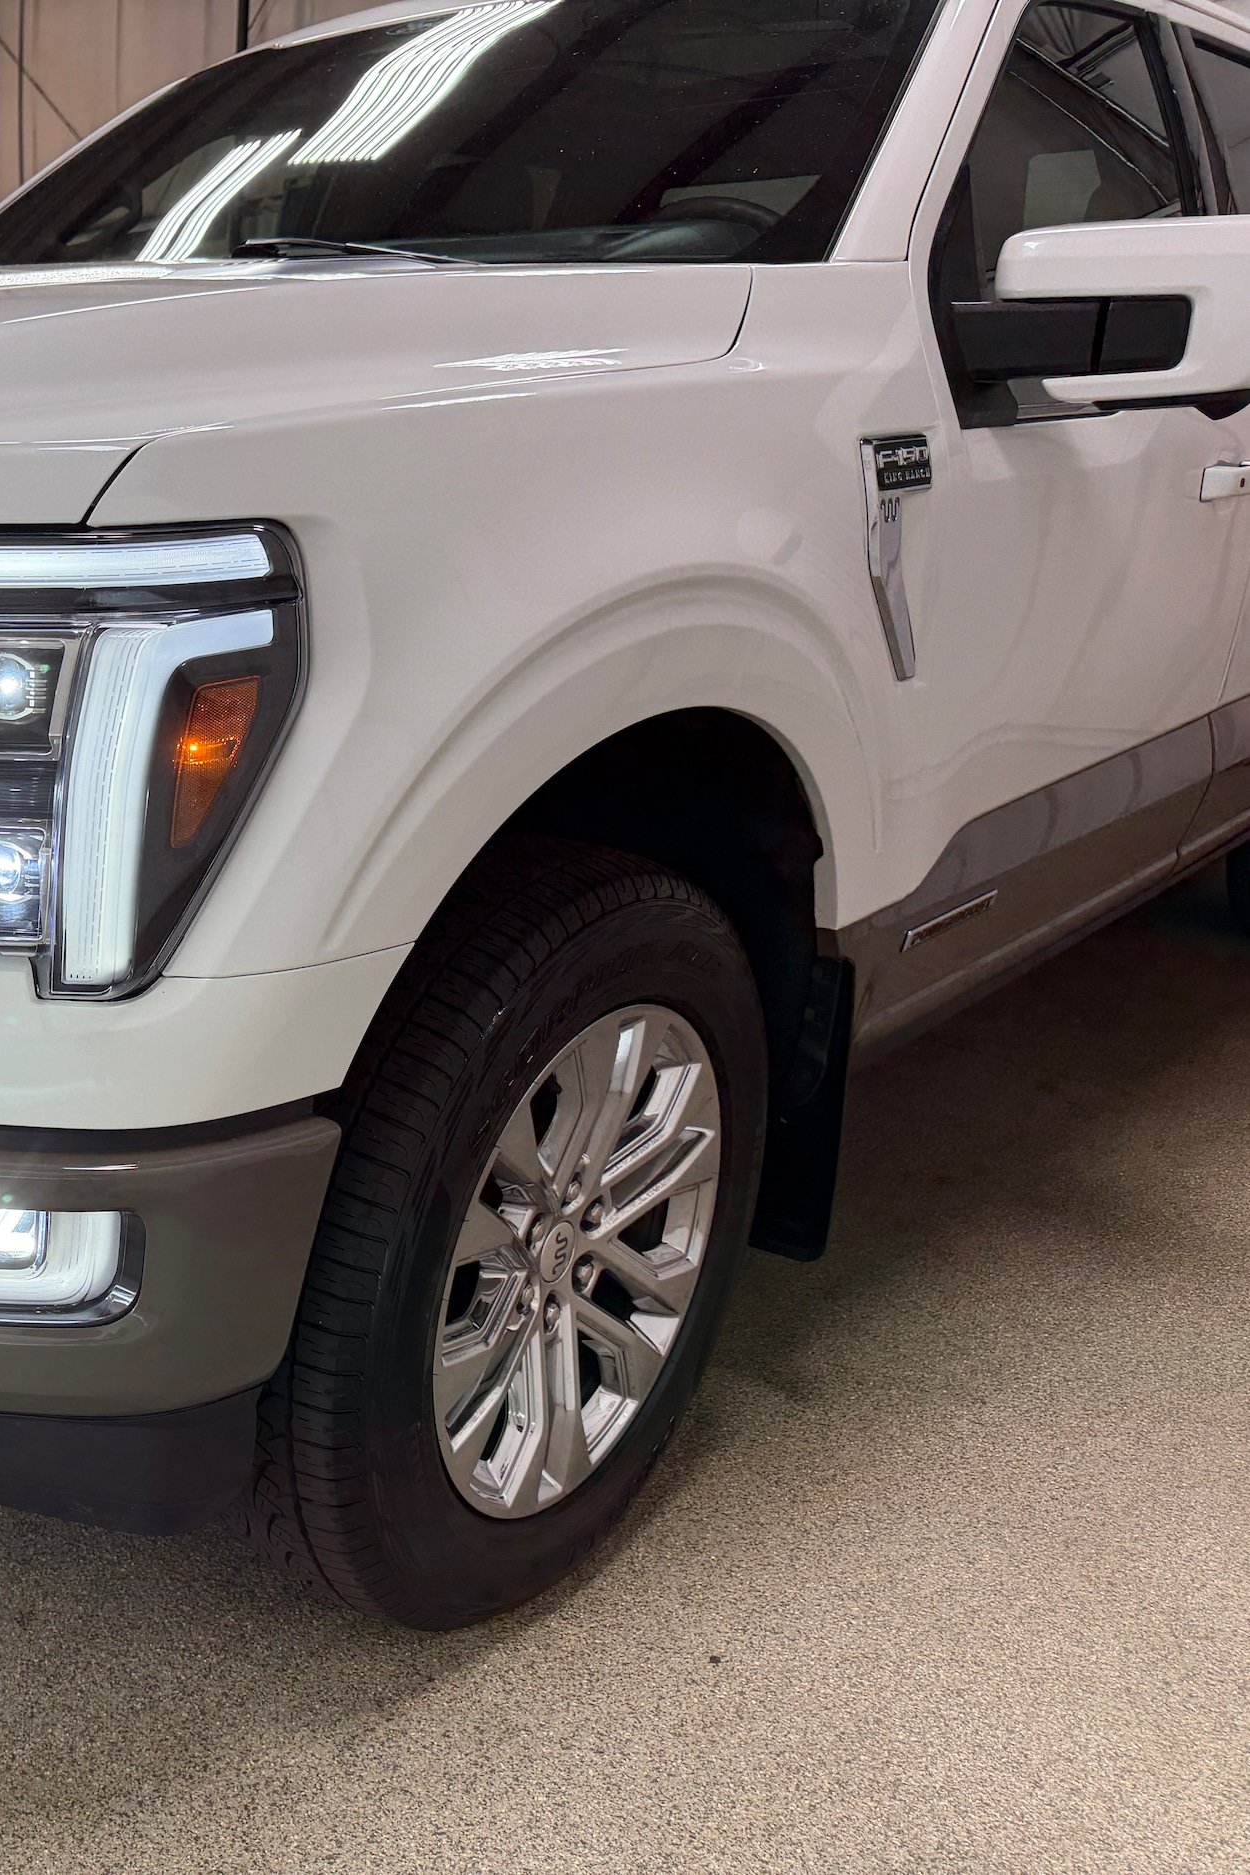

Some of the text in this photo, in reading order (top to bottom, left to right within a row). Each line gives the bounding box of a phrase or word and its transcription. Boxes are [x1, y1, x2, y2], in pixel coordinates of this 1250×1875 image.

[875, 445, 929, 469] F-150
[883, 466, 931, 484] KING RANCH
